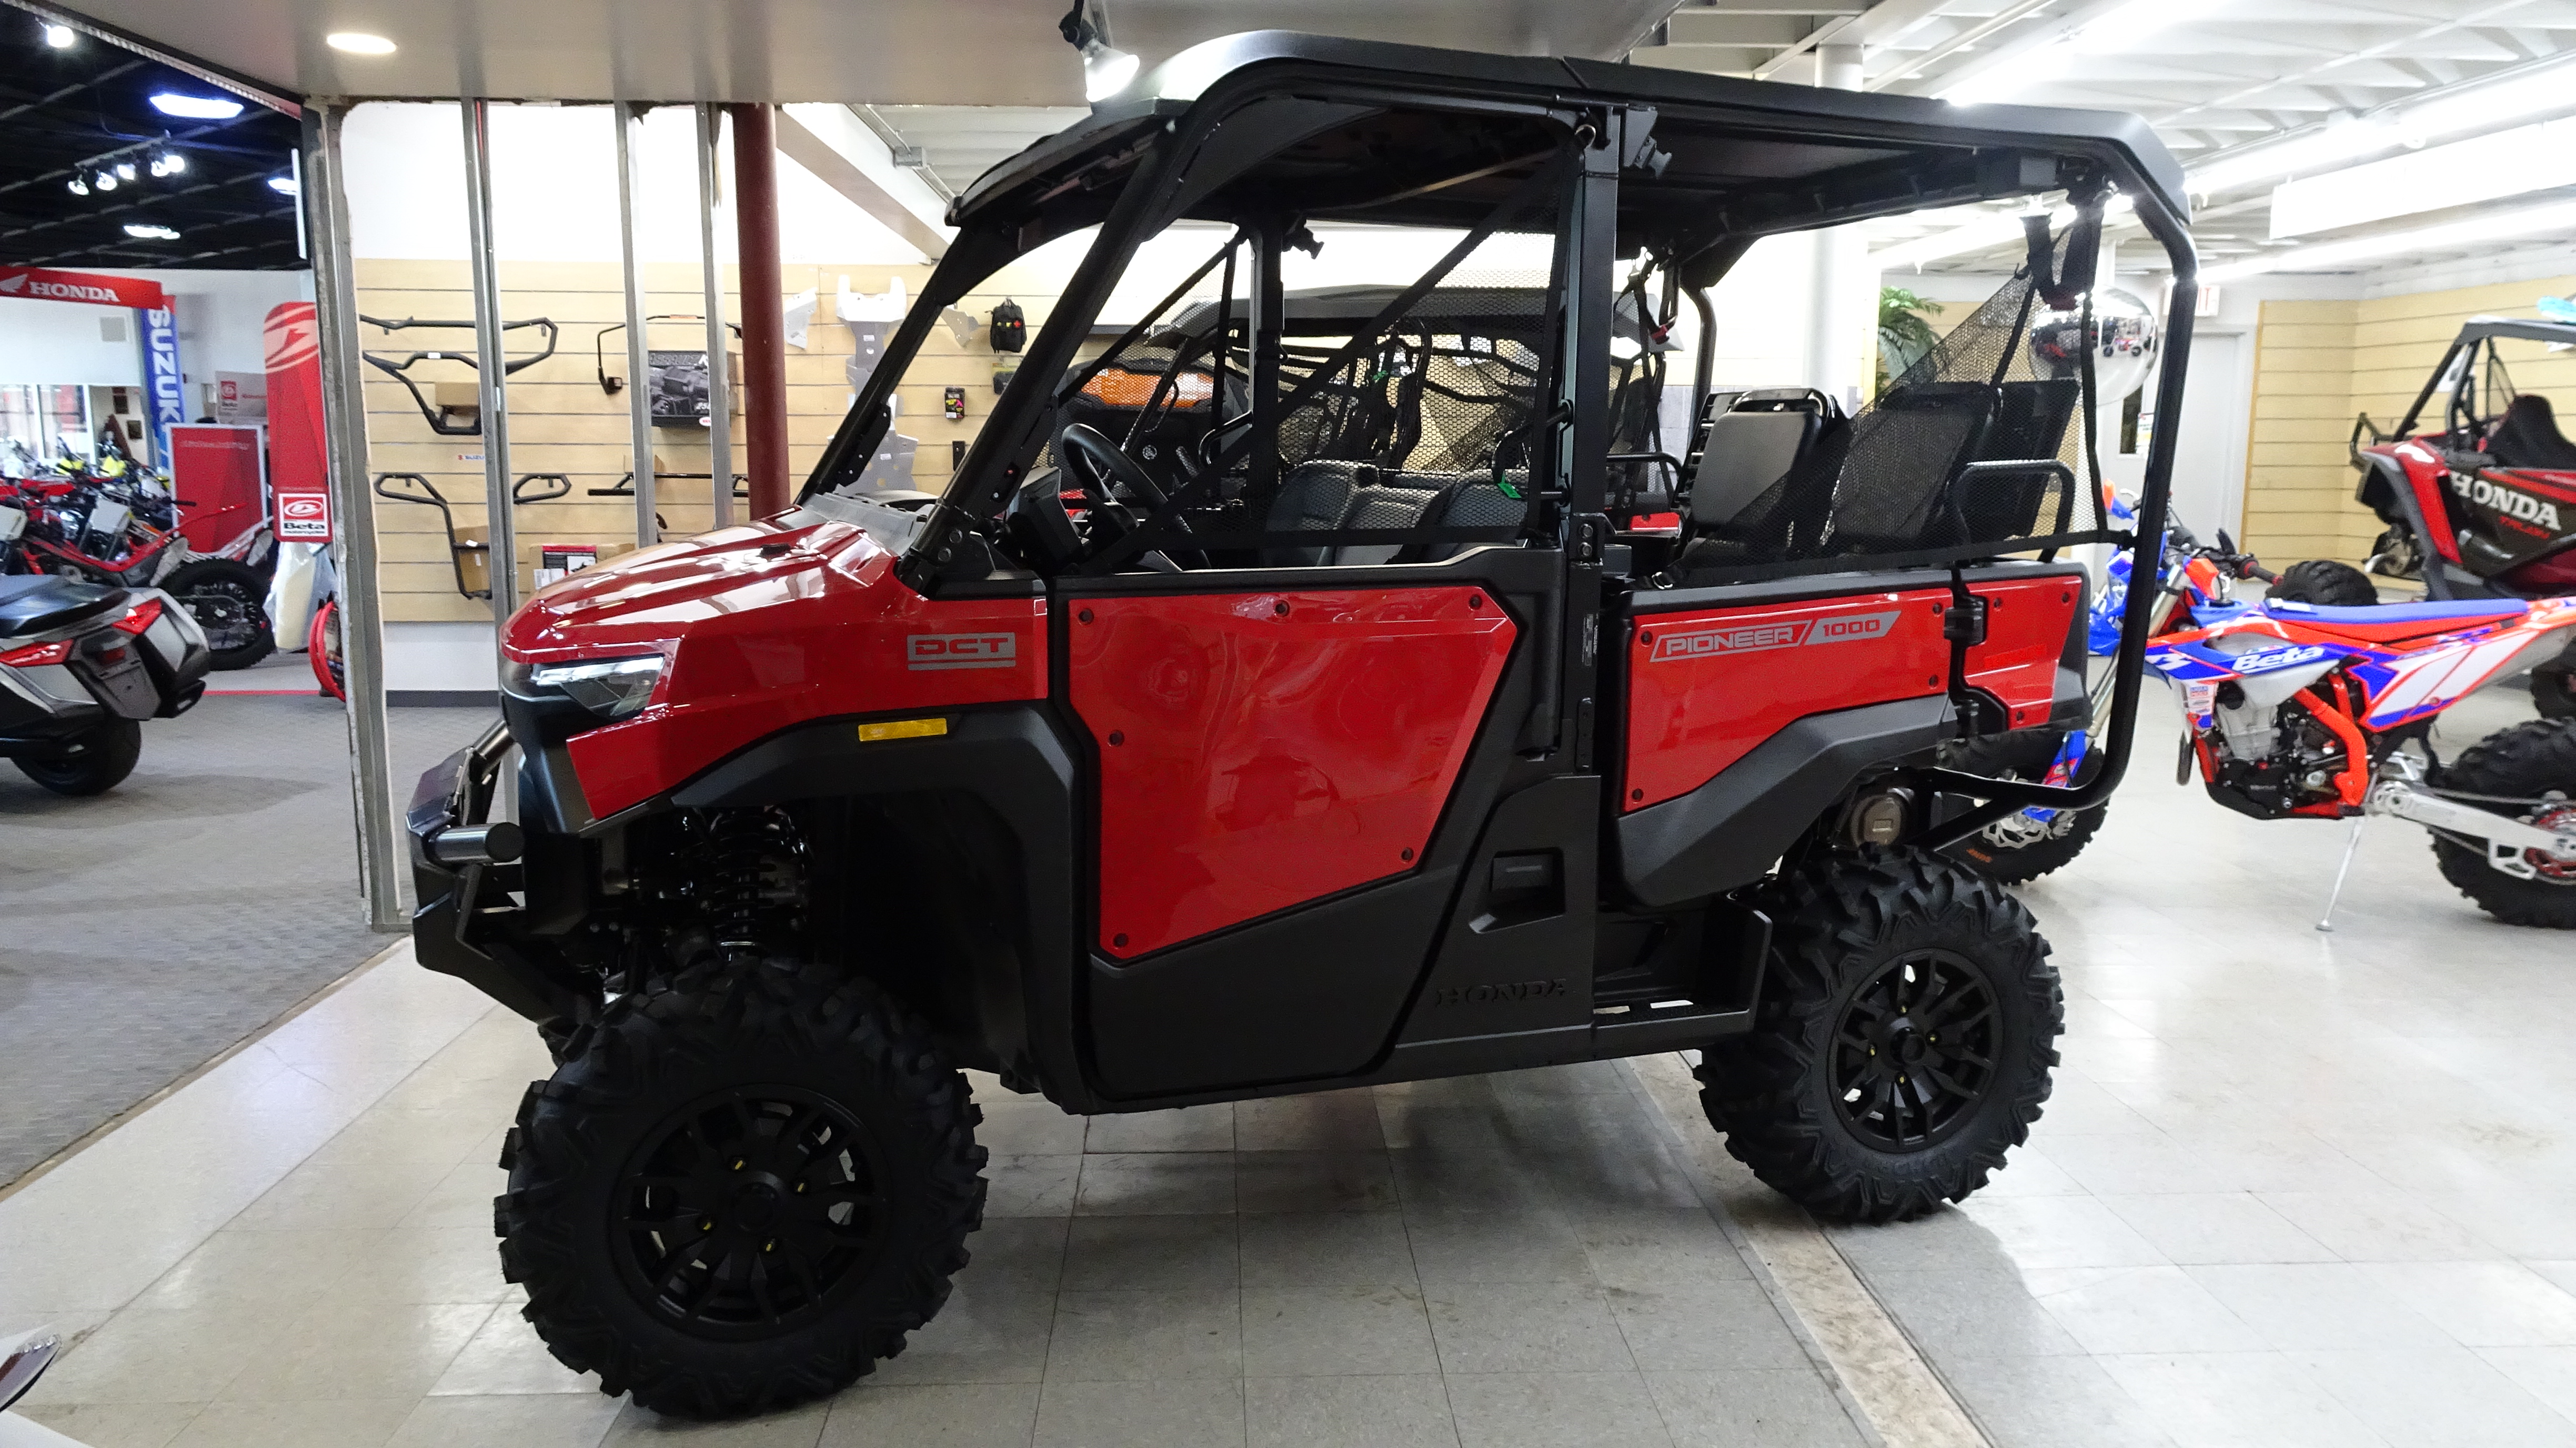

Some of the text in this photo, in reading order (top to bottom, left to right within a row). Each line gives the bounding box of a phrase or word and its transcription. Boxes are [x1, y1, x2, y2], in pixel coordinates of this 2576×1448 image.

[28, 281, 120, 302] HONDA
[148, 304, 182, 424] SUZUK
[2449, 470, 2561, 531] HONDA
[915, 638, 1009, 655] DCT
[1666, 619, 1880, 656] PIONEER 1000
[2232, 646, 2325, 671] Beta
[1435, 978, 1566, 1009] HONDA
